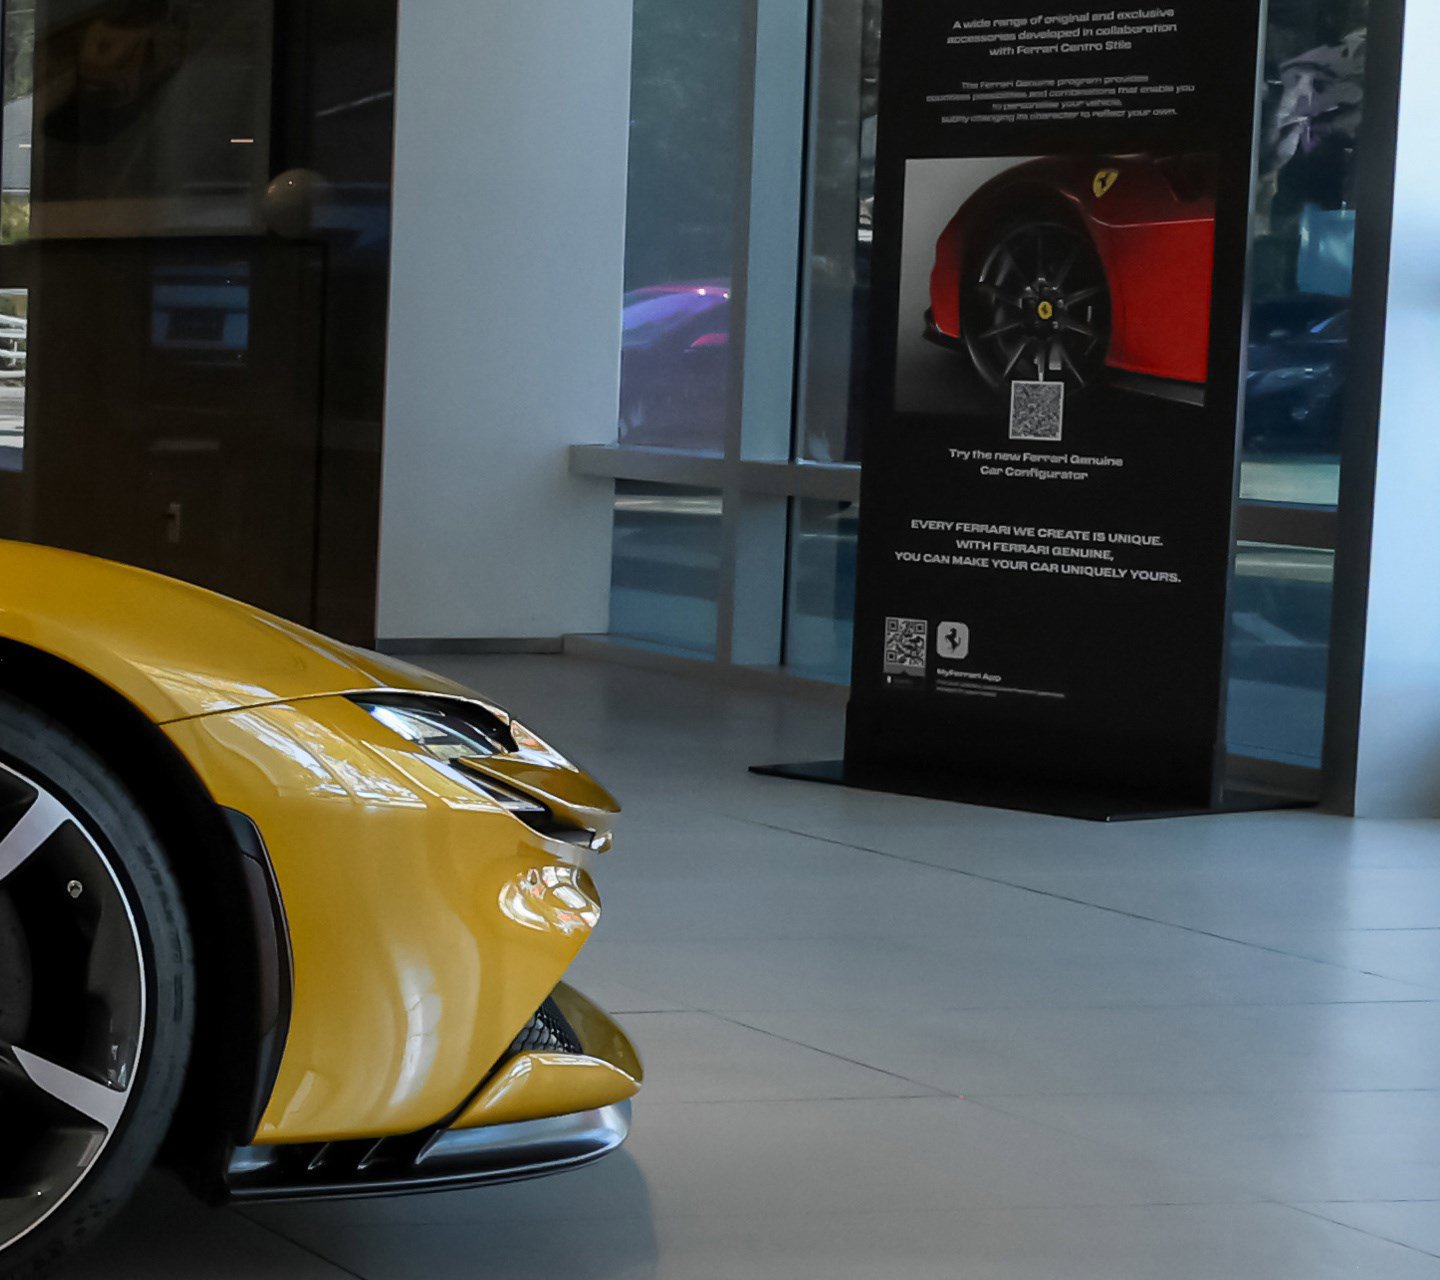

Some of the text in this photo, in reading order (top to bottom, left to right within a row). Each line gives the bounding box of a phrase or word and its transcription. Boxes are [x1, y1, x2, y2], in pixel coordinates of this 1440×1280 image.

[952, 8, 1175, 30] A wide range of original and exclusive
[1018, 28, 1080, 40] developed
[1082, 28, 1094, 37] in
[1095, 23, 1178, 36] collaboration
[989, 40, 1133, 56] with Ferrari Centro Stile
[949, 448, 1123, 467] Try the new Ferrari Genuine
[980, 465, 1088, 480] Car Configurator
[911, 519, 1164, 546] EVERY FERRARI WE CREATE IS UNIQUE.
[956, 539, 1114, 561] WITH FERRARI GENUINE,
[894, 551, 1182, 583] YOU CAN MAKE YOUR CAR UNIQUELY YOURS.
